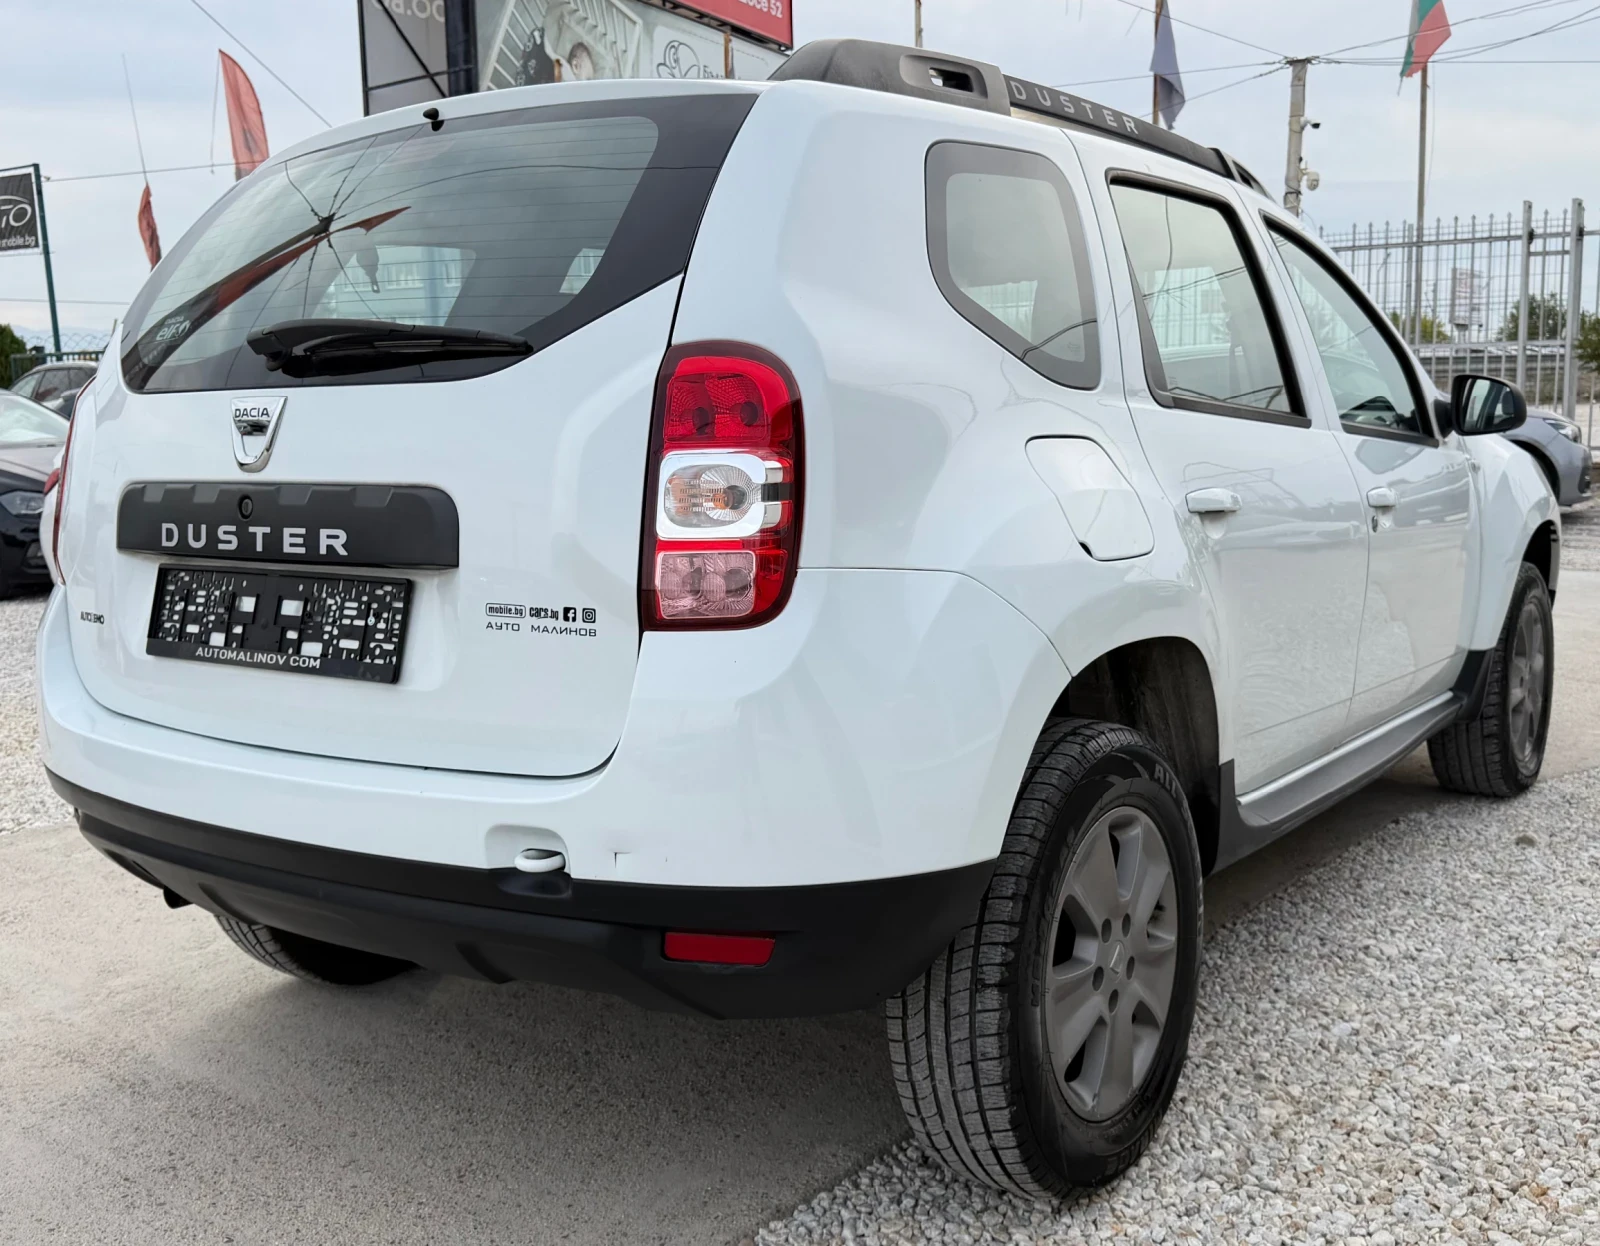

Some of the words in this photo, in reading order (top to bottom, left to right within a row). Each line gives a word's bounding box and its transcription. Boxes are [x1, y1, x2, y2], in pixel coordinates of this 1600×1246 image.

[1009, 80, 1139, 135] DUSTER
[156, 322, 182, 340] elf
[234, 407, 270, 418] DACIA
[161, 523, 348, 556] DUSTER
[488, 605, 523, 617] mobile.bg
[529, 606, 559, 621] cars.bg
[486, 621, 520, 632] АУТО
[531, 624, 597, 637] МАЛИНОВ
[1154, 763, 1177, 799] ALL
